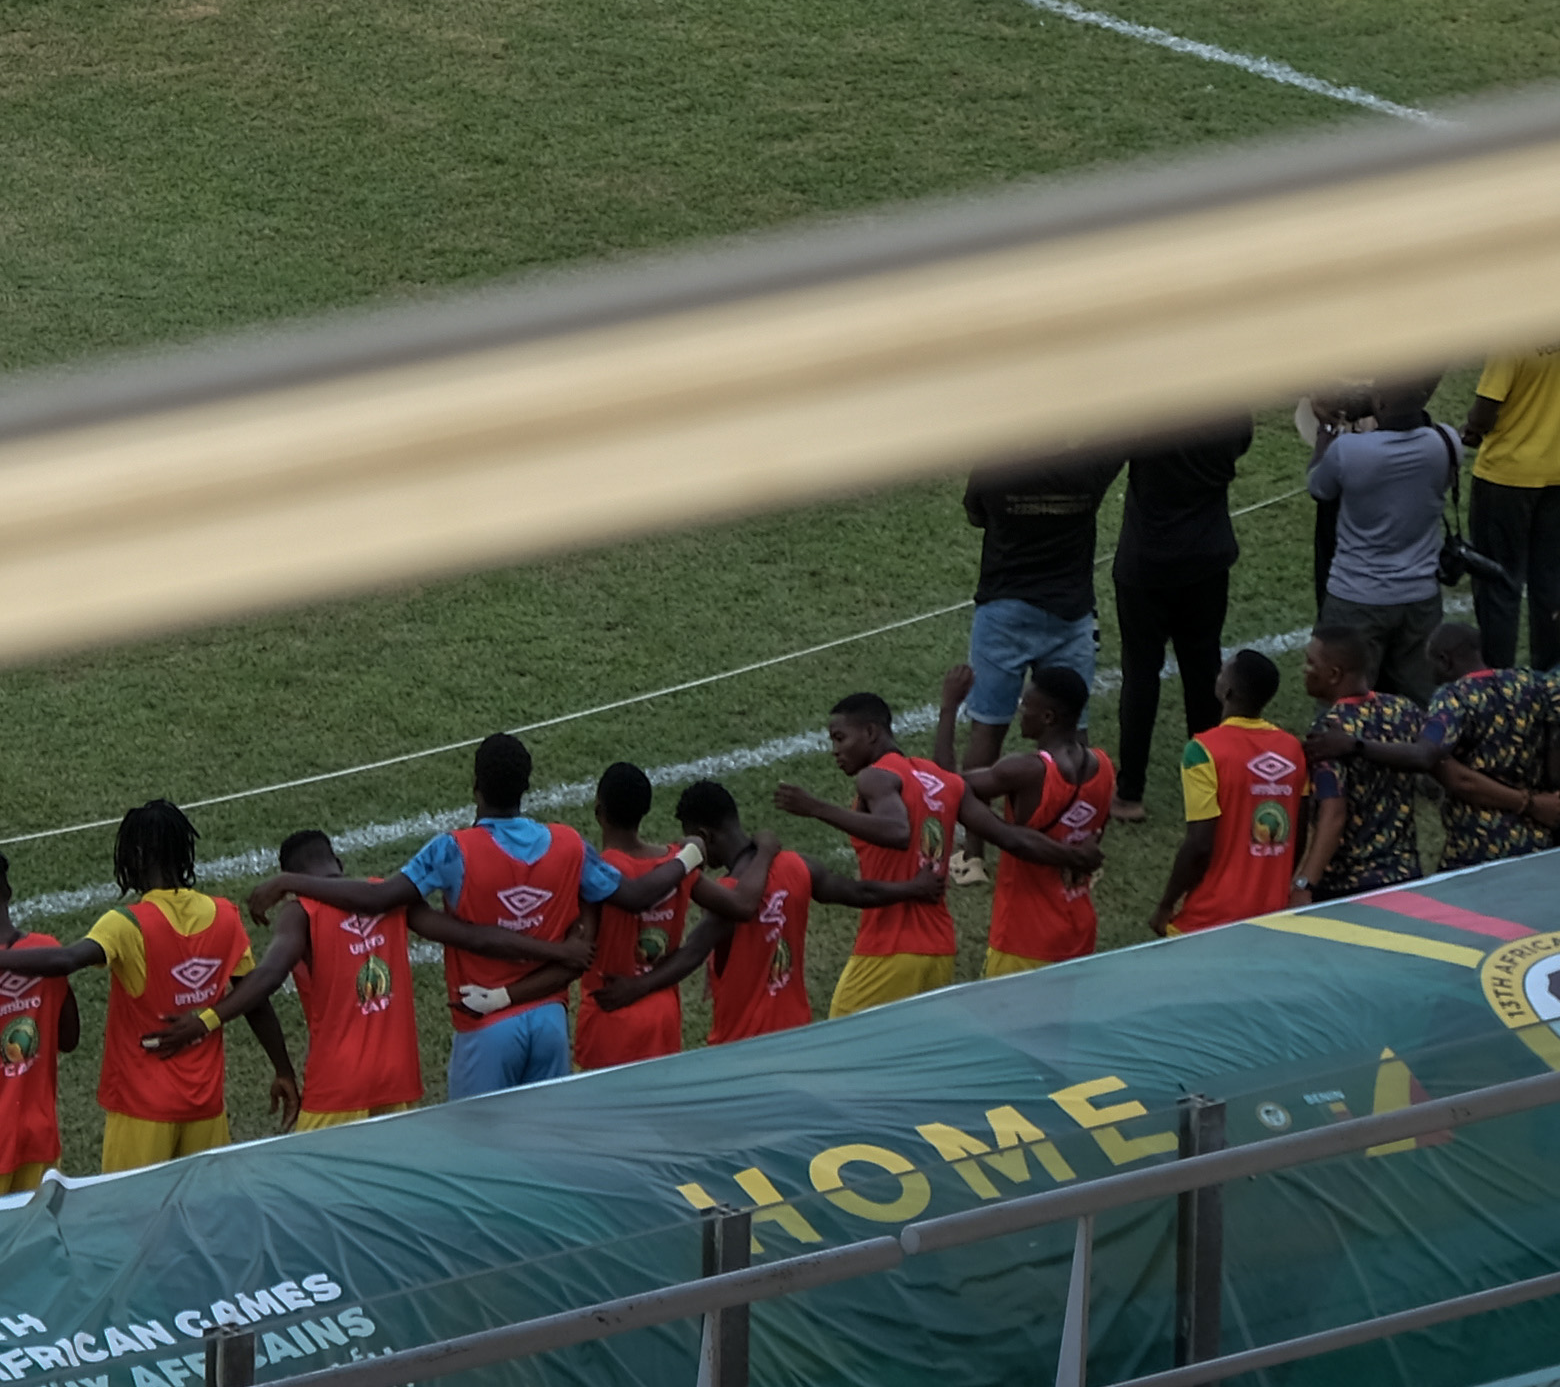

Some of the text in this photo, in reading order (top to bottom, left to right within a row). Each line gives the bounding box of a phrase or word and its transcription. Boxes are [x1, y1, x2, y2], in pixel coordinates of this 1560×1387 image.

[1491, 975, 1525, 1018] 13TH
[676, 1075, 1179, 1254] HOME
[174, 1273, 343, 1339] GAMES
